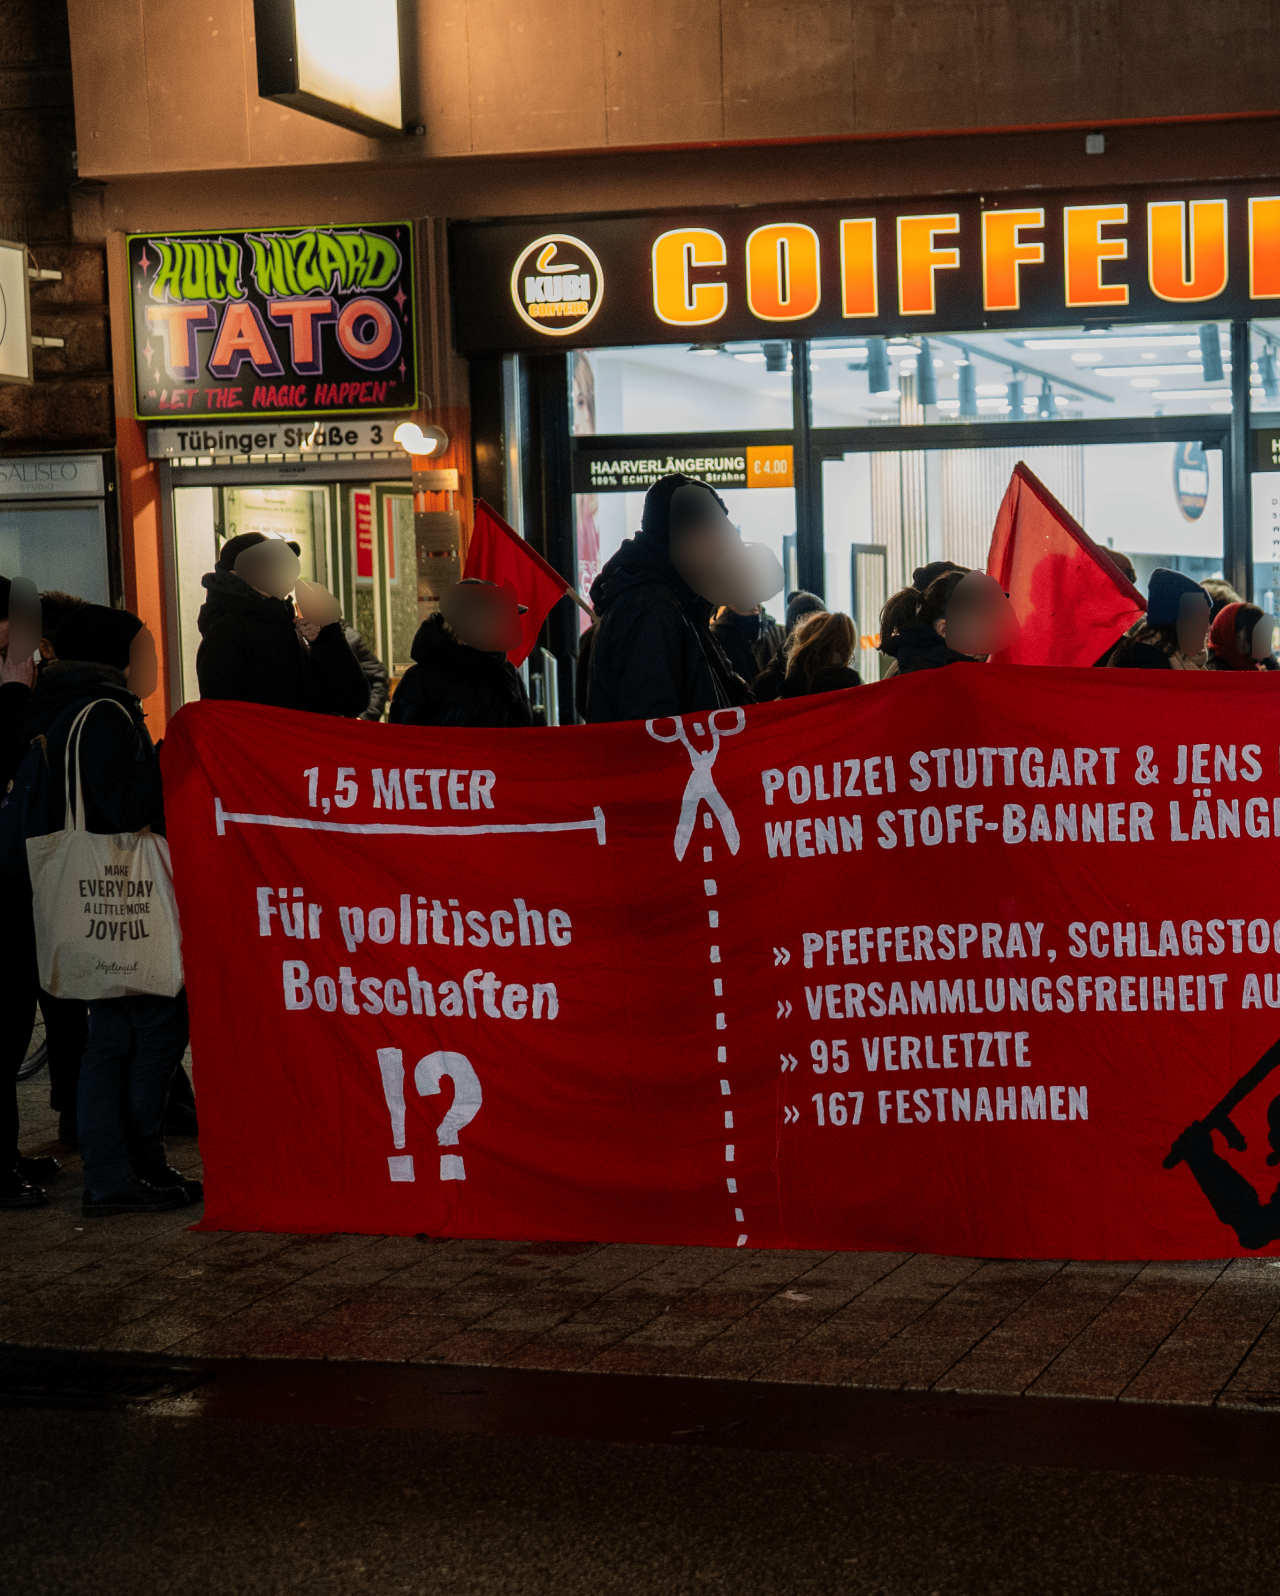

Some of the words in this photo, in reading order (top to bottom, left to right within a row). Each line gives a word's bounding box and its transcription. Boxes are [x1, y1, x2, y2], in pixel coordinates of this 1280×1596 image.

[149, 238, 246, 302] HOLY
[246, 230, 400, 298] WIZARD
[525, 274, 591, 303] KUBI
[146, 297, 399, 375] TATO
[204, 387, 243, 409] THE
[252, 385, 307, 408] MAGIC
[177, 430, 277, 454] Tübinger
[284, 426, 359, 448] Straße
[370, 425, 384, 446] 3
[590, 456, 745, 475] HAARVERLÄNGERUNG
[591, 475, 617, 486] 100%
[622, 473, 663, 485] ECHTHA
[705, 472, 746, 483] Strähne
[754, 459, 761, 474] €
[302, 766, 359, 815] 1,5
[371, 768, 497, 811] METER
[761, 756, 897, 805] POLIZEI
[909, 747, 1120, 792] STUTTGART
[1134, 745, 1160, 786] &
[1173, 743, 1263, 785] JENS
[764, 814, 863, 858] WENN
[876, 802, 1155, 850] STOFF-BANNER
[78, 879, 124, 898] EVERY
[127, 880, 153, 898] DAY
[104, 865, 129, 877] MAKE
[84, 902, 91, 914] A
[93, 903, 125, 916] LITTLE
[127, 902, 150, 915] MORE
[85, 918, 150, 942] JOYFUL
[256, 886, 322, 940] Für
[339, 894, 573, 953] politische
[802, 921, 1057, 969] PFEFFERSPRAY,
[282, 960, 560, 1020] Botschaften
[804, 973, 1228, 1020] VERSAMMLUNGSFREIHEIT
[810, 1038, 850, 1074] 95
[861, 1031, 1032, 1072] VERLETZTE
[376, 1047, 483, 1183] !?
[811, 1091, 864, 1126] 167
[878, 1085, 1089, 1125] FESTNAHMEN
